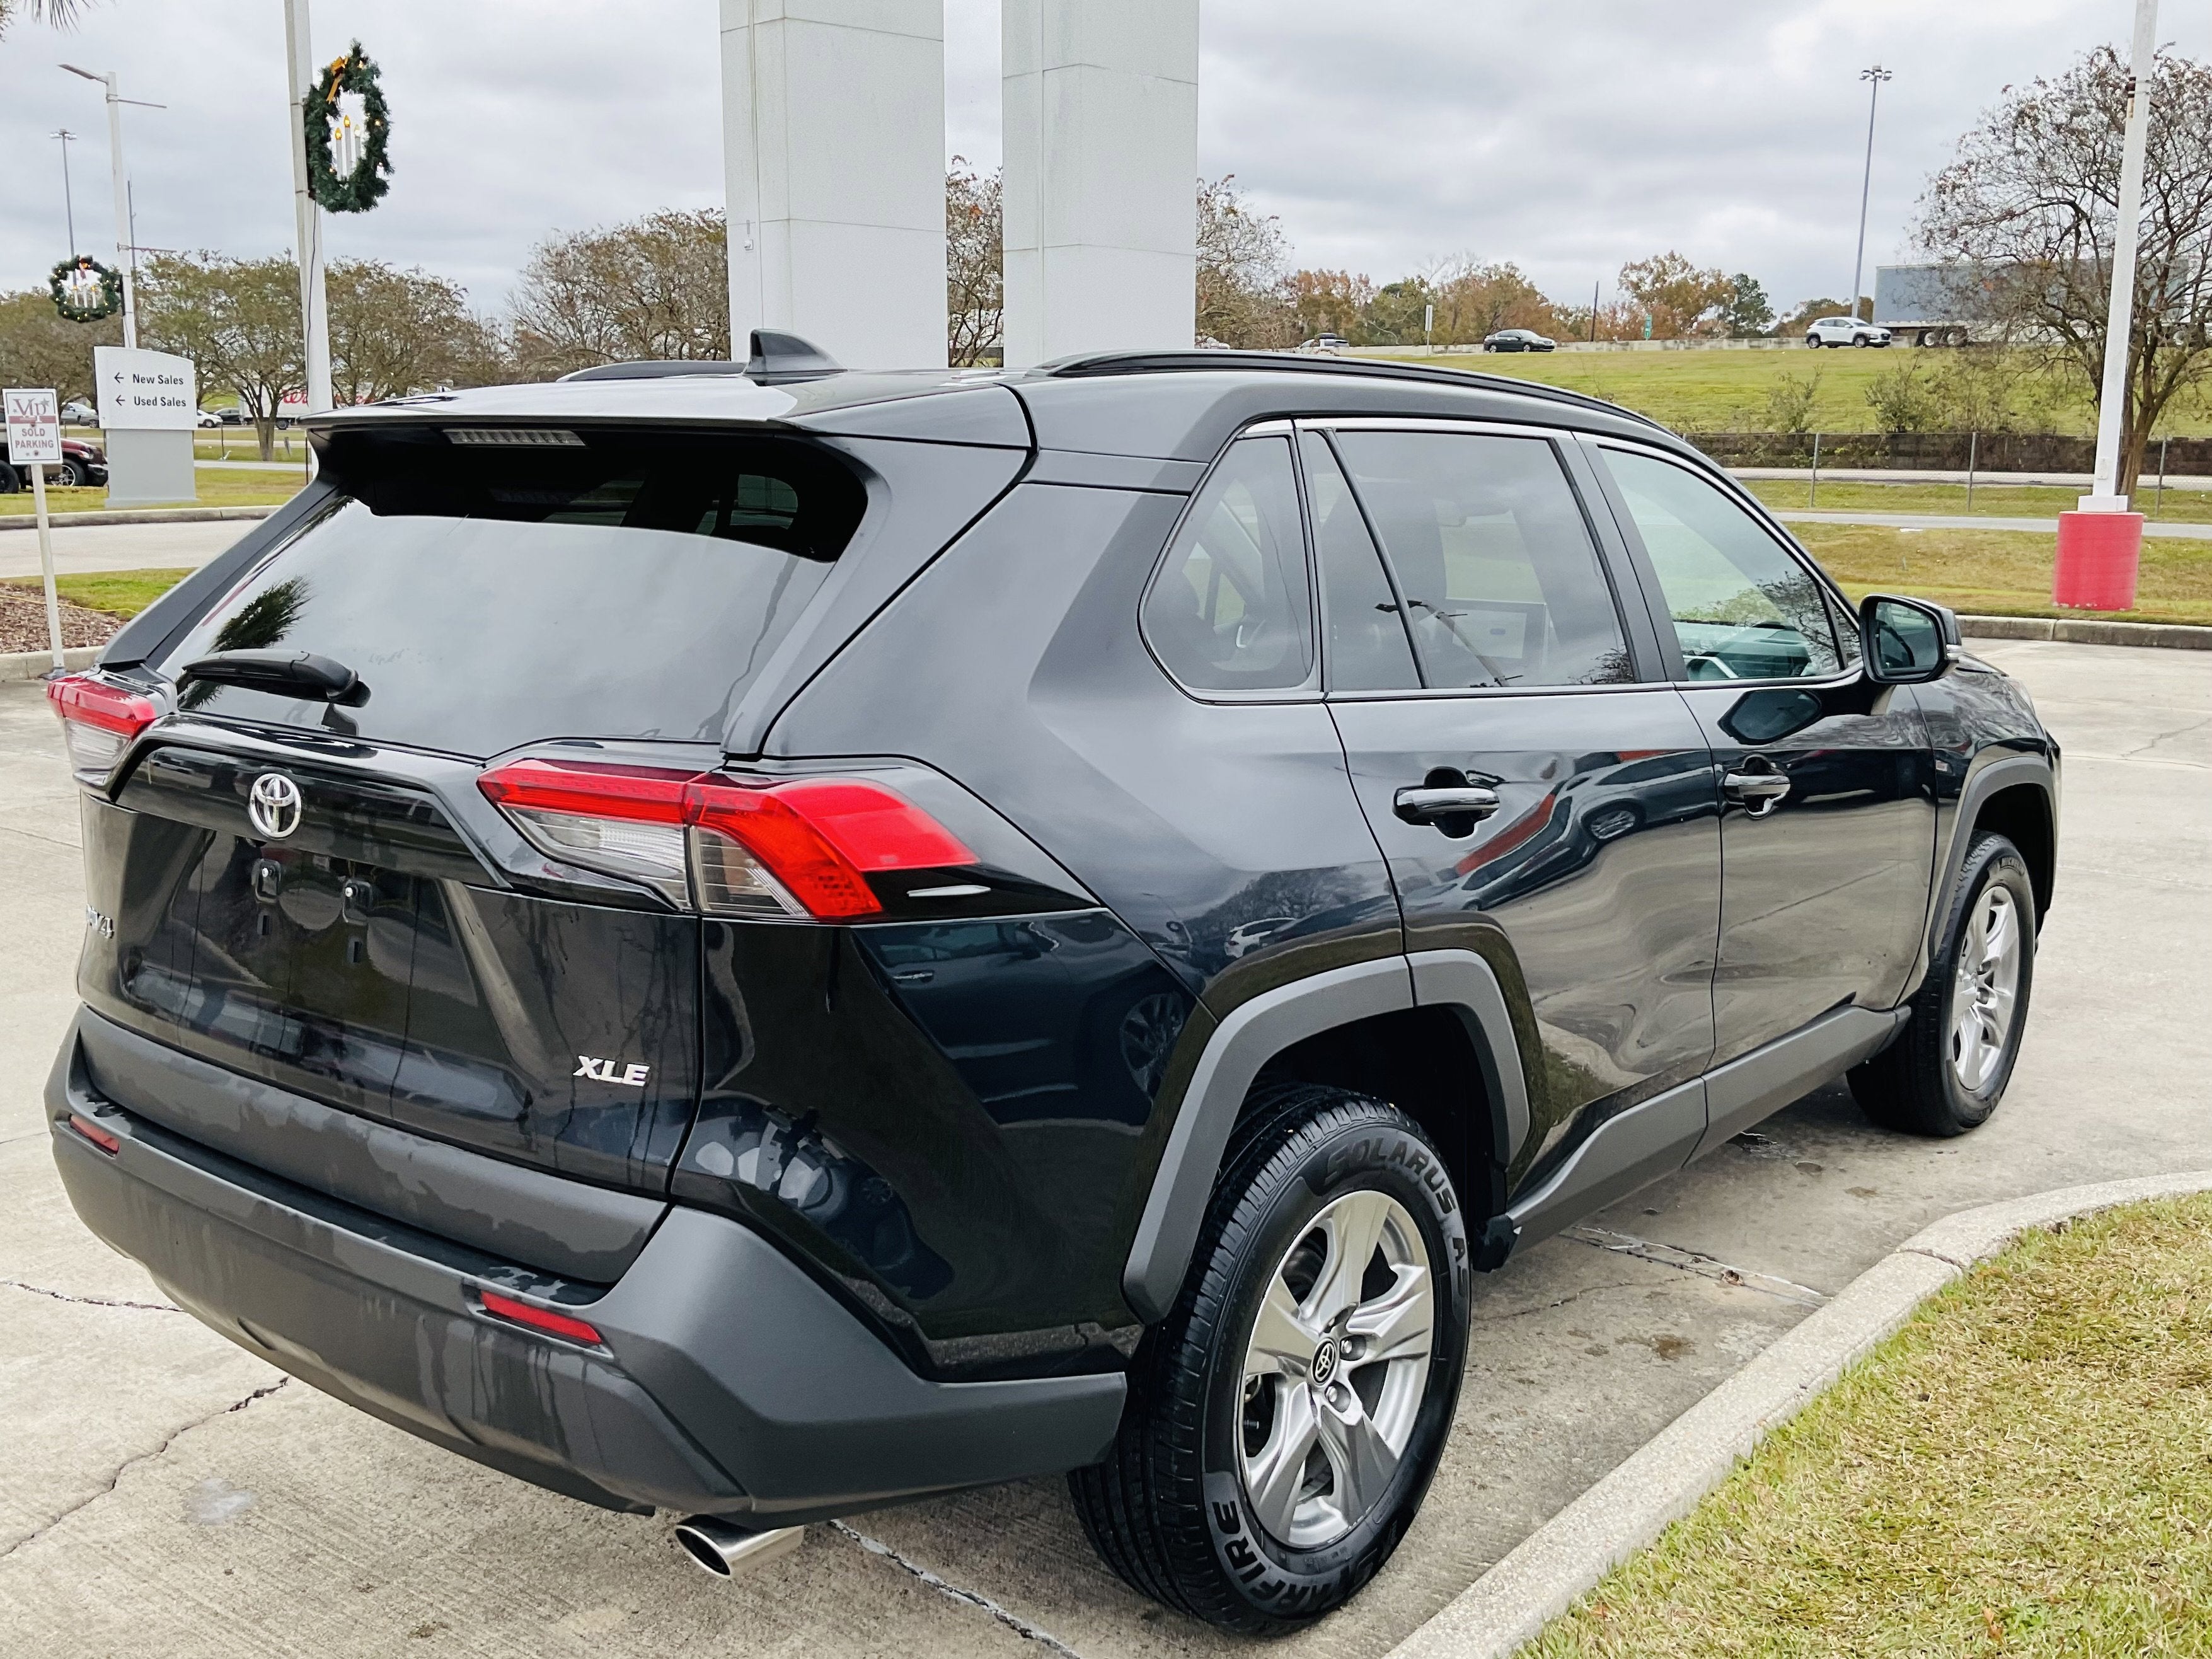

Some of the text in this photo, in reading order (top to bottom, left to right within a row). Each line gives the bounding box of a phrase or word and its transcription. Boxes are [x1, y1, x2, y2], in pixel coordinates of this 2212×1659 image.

[132, 373, 184, 385] New Sales
[134, 395, 187, 407] Used Sales
[21, 428, 45, 437] SOLD
[15, 439, 54, 449] PARKING
[572, 1055, 650, 1087] XLE
[1323, 1137, 1469, 1298] SOLARUS AS
